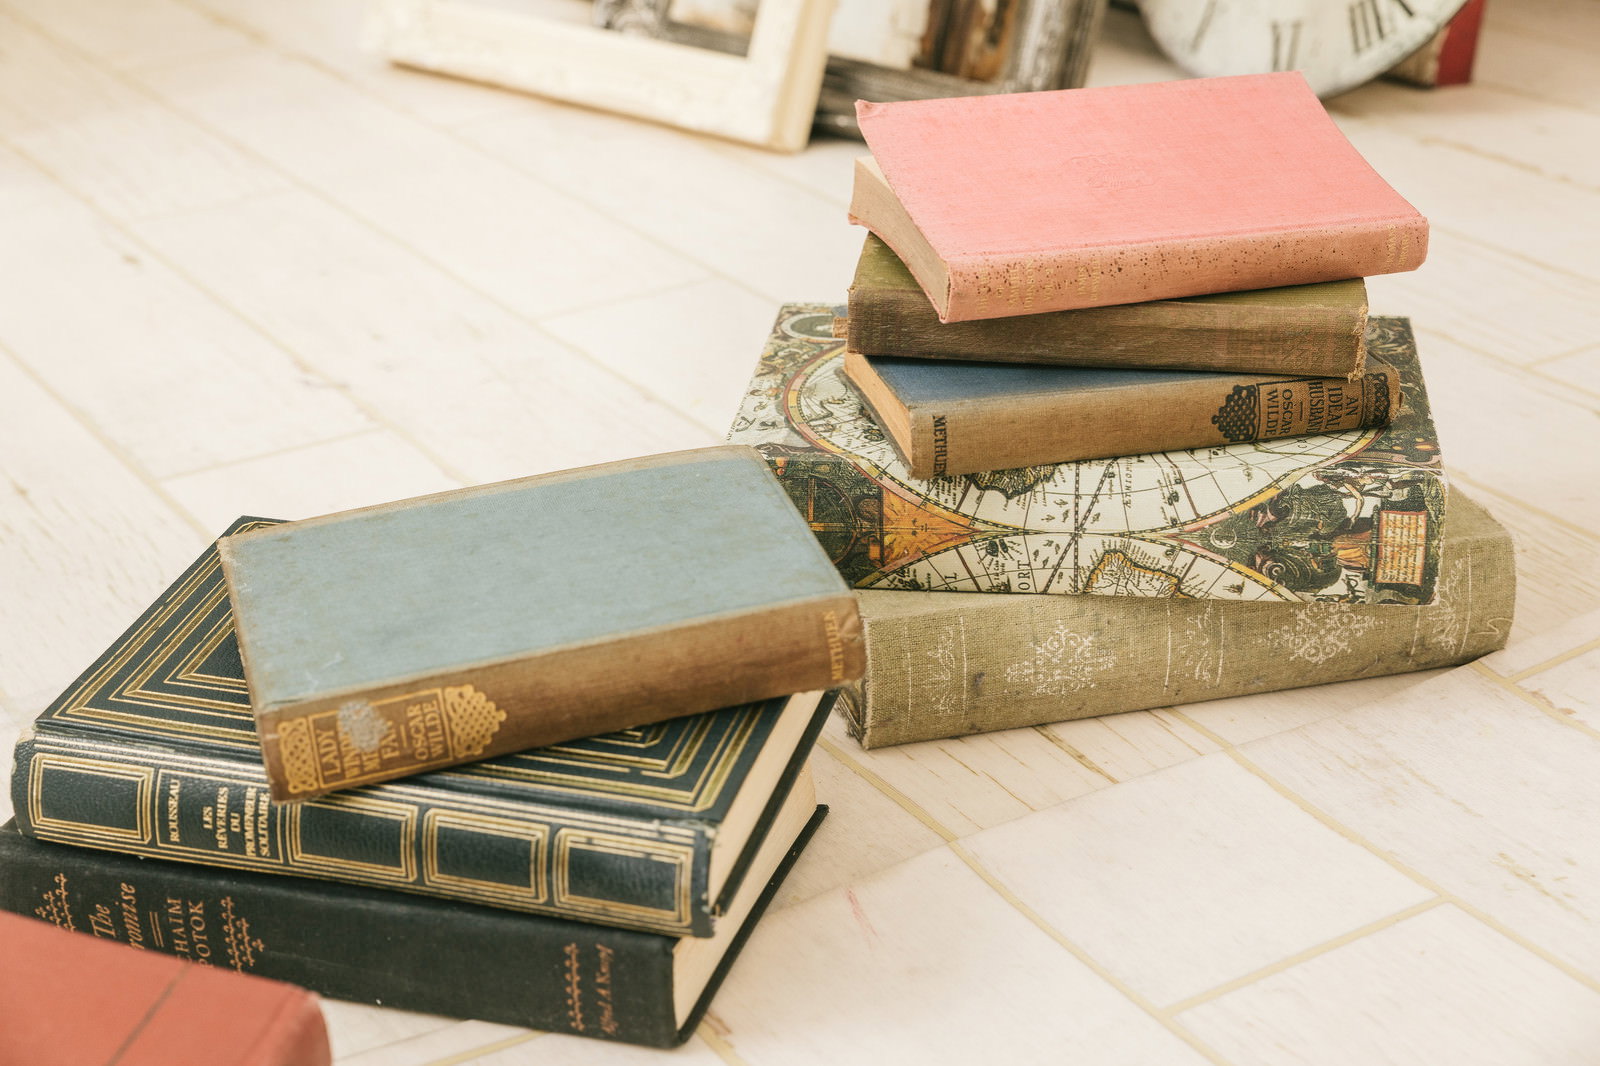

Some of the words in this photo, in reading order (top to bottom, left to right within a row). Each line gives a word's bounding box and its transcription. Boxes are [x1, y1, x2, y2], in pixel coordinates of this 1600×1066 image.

[1023, 258, 1034, 312] JOHNSON
[1264, 388, 1279, 437] WILDE
[1279, 388, 1294, 436] OSCAR
[1305, 381, 1325, 434] HUSBAND
[1324, 386, 1344, 431] IDEAL
[1345, 395, 1360, 417] AN
[932, 414, 948, 477] METHUEN
[1017, 559, 1031, 591] ORT
[823, 610, 845, 681] METHUEN
[316, 727, 341, 777] LADY
[406, 703, 428, 761] OSCAR
[422, 699, 444, 758] WILDE
[168, 778, 181, 842] ROUSSEAU
[202, 806, 213, 830] LES
[215, 786, 229, 849] RÊVERIES
[230, 811, 241, 833] DU
[244, 787, 257, 857] PROMENEUR
[258, 792, 271, 857] SOLITAIRE
[88, 903, 117, 938] The
[115, 882, 145, 950] romise
